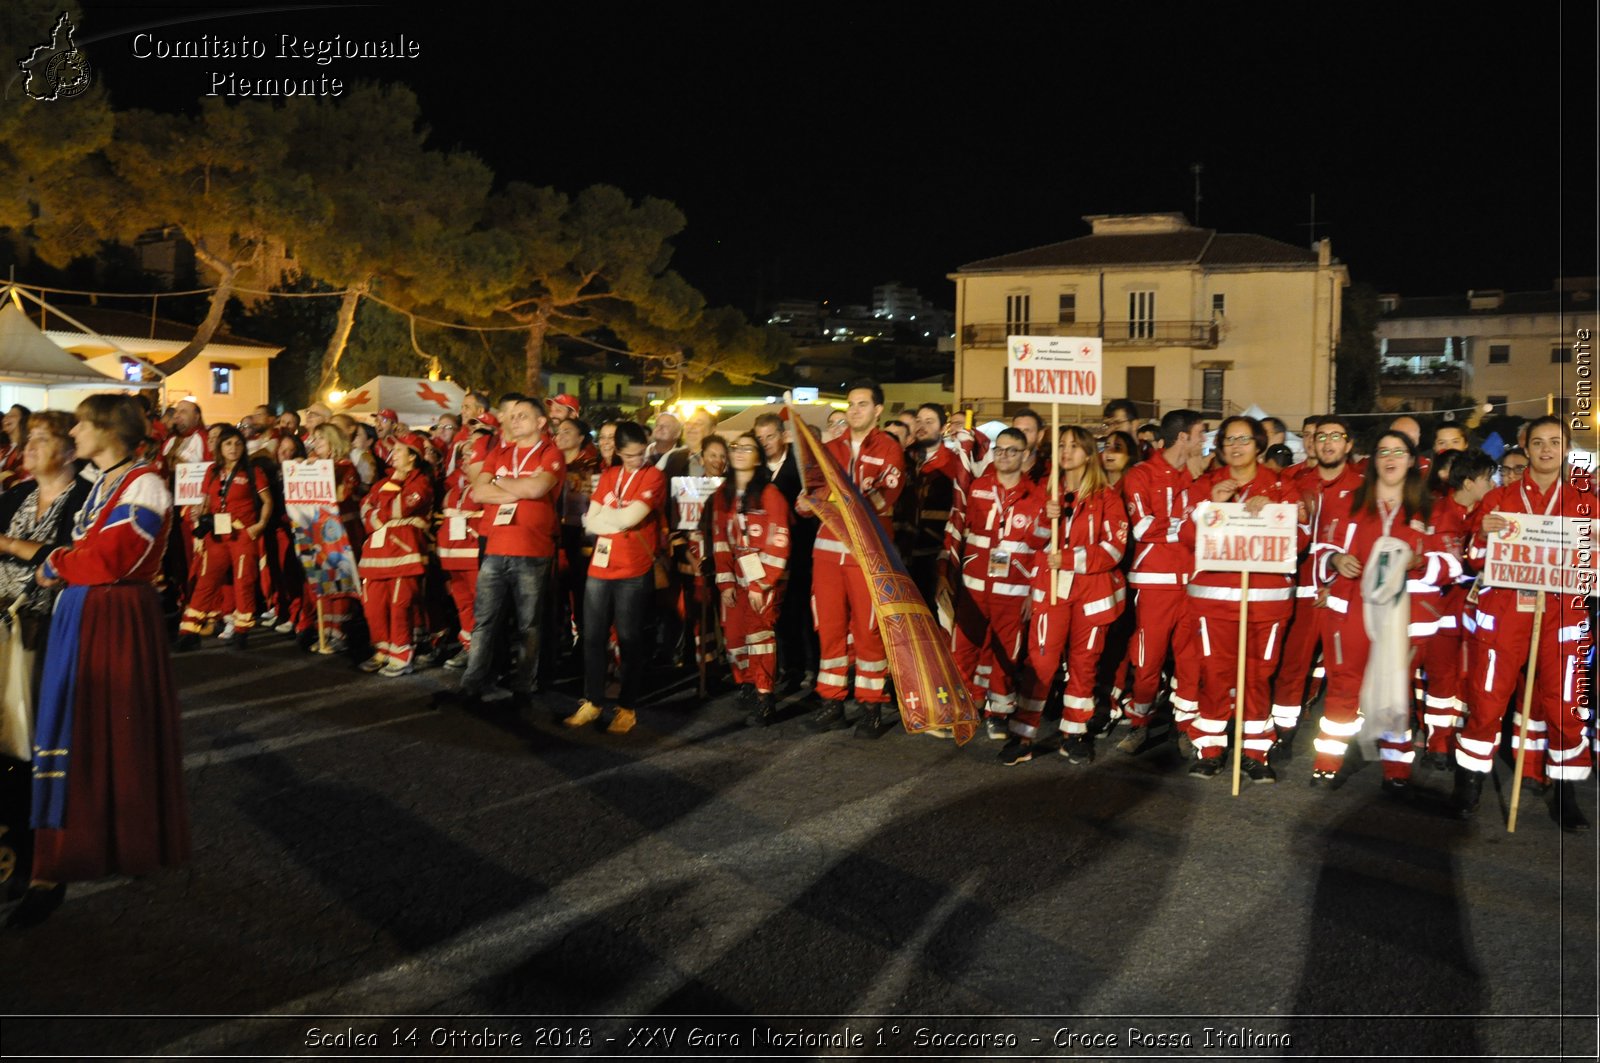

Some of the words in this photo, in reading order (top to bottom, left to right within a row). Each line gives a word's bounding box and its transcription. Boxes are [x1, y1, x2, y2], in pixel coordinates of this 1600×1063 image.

[1013, 368, 1097, 397] TRENTINO
[288, 481, 333, 499] PUGLIA
[1202, 534, 1291, 562] MARCHE
[1490, 562, 1546, 586] VENEZIA
